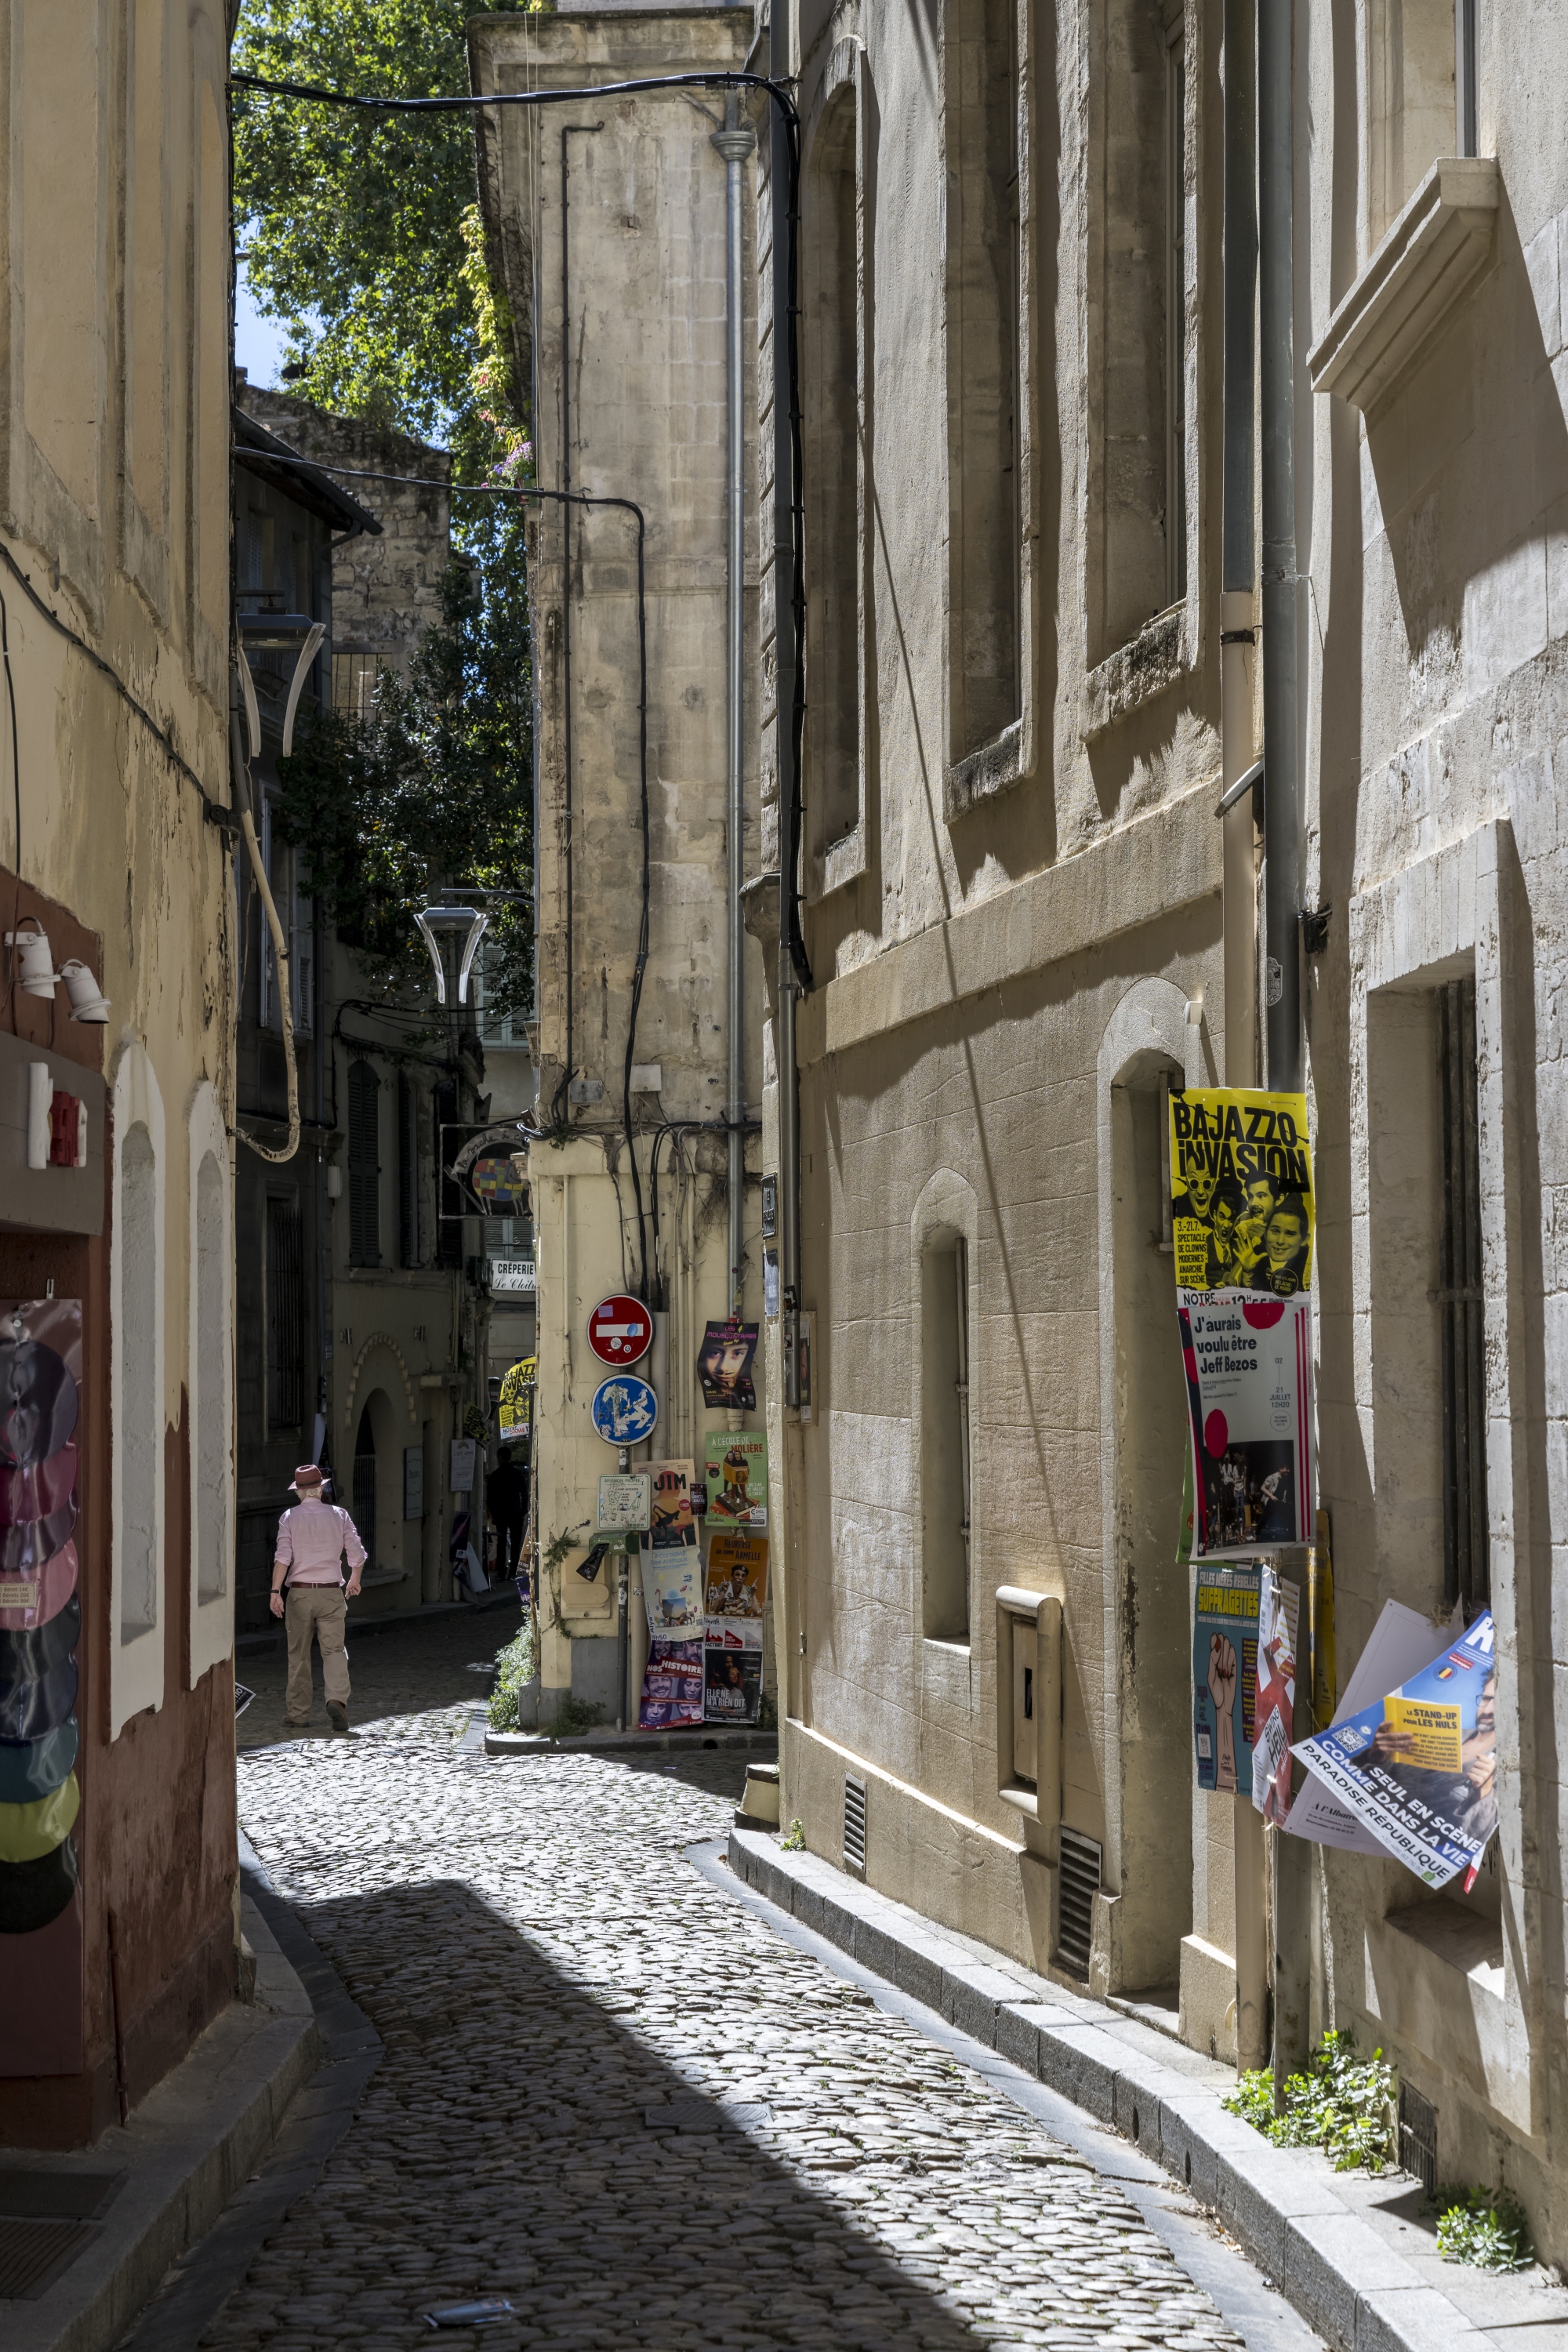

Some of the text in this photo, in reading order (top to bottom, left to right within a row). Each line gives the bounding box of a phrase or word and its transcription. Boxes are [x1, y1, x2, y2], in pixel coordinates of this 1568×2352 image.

[1173, 1102, 1297, 1148] BAJAZZO
[468, 1133, 497, 1154] vache
[1178, 1233, 1205, 1242] SPECTACLE
[1185, 1244, 1206, 1252] CLOWNS
[1179, 1254, 1204, 1263] MODERNES
[498, 1262, 534, 1274] CRÊPERIE
[1179, 1265, 1203, 1274] ANARCHIE
[495, 1278, 506, 1289] Le
[1180, 1273, 1205, 1284] SUR SCÈNE
[1183, 1293, 1216, 1306] NOTRE
[1194, 1314, 1241, 1333] J'aurais
[707, 1332, 757, 1340] MOUSQUETAIRES
[1196, 1335, 1257, 1353] voulu être
[1200, 1356, 1258, 1374] Jeff Bezos
[712, 1436, 749, 1446] À L'ÉCOLE DE
[731, 1442, 763, 1453] MOLIÈRE
[654, 1474, 686, 1491] JIM
[724, 1539, 751, 1549] HEUREUSE
[735, 1550, 761, 1560] ARMELLE
[1199, 1571, 1259, 1590] FILLES MÈRES REBELLES
[1198, 1586, 1258, 1618] SUFFRAGETTES
[707, 1688, 730, 1698] ELLE NE
[706, 1697, 717, 1708] M'A
[718, 1698, 733, 1707] RIEN
[734, 1699, 745, 1708] DIT
[1414, 1709, 1456, 1719] STAND-UP
[1265, 1707, 1279, 1743] SWING
[1418, 1719, 1433, 1727] LES
[1435, 1720, 1457, 1729] NULS
[1269, 1724, 1286, 1770] HEIL
[1322, 1740, 1377, 1793] COMME
[1375, 1791, 1420, 1829] DANS
[1417, 1827, 1440, 1849] LA
[1442, 1841, 1469, 1866] VIE
[1302, 1744, 1368, 1806] PARADISE
[1365, 1806, 1450, 1879] RÉPUBLIQUE
[1370, 1767, 1482, 1853] SEUL EN SCÈNE
